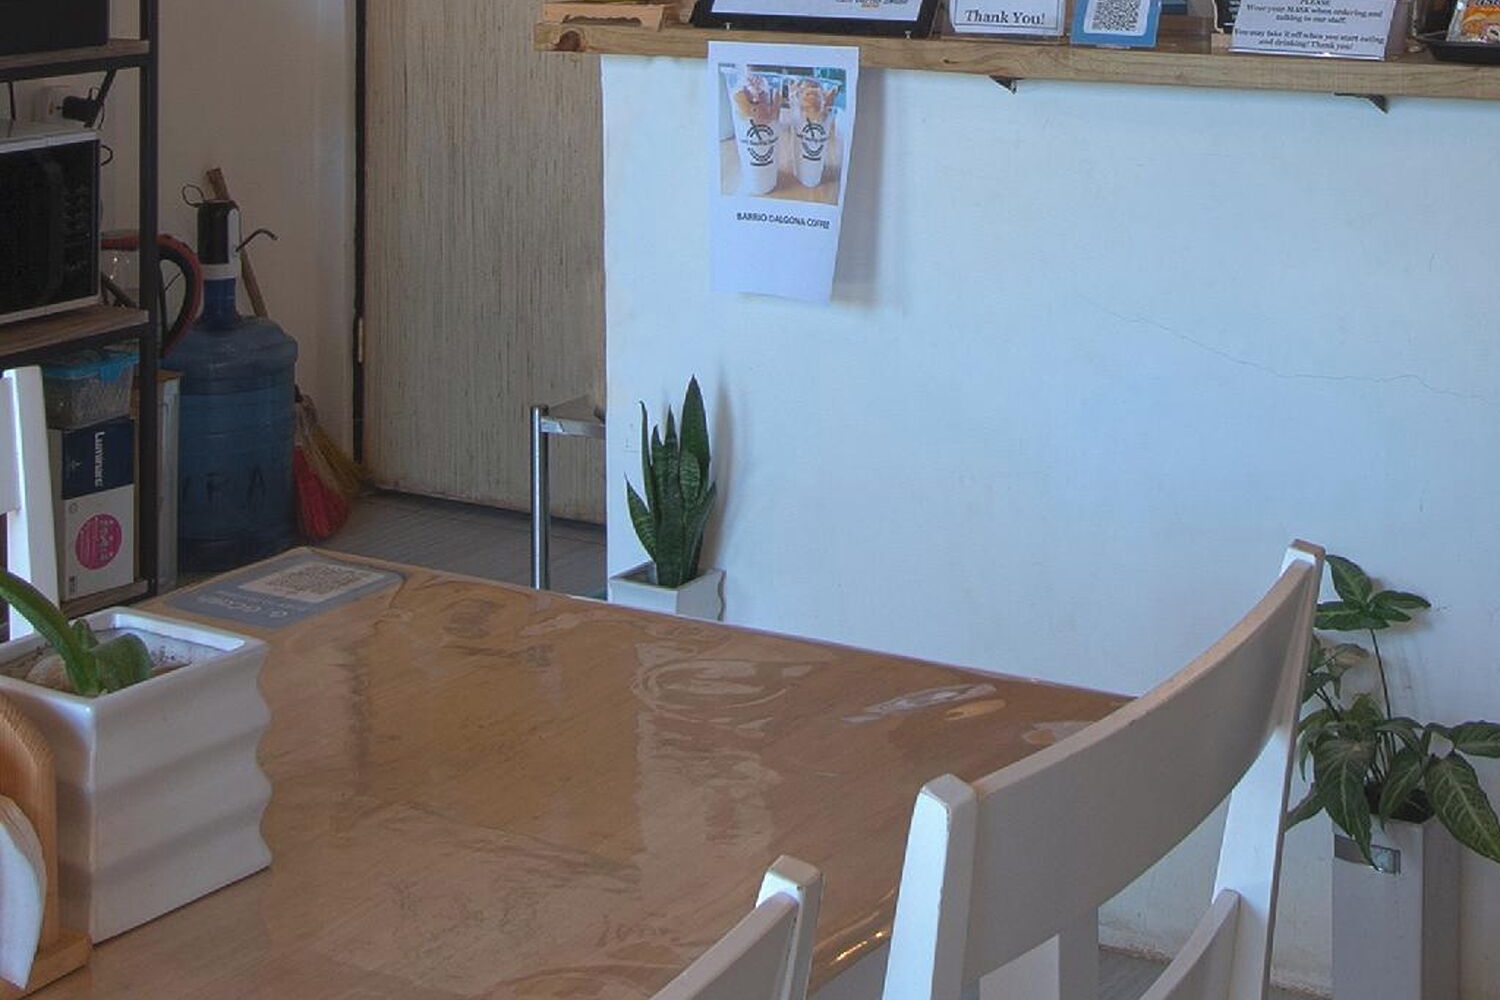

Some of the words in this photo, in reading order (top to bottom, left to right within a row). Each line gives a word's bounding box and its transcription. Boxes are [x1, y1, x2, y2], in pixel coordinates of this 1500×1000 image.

[965, 9, 1009, 25] Thank
[1013, 11, 1046, 26] You!
[1287, 6, 1310, 14] MASK
[1340, 33, 1359, 42] start
[736, 211, 768, 222] BARRIO
[769, 213, 806, 226] DALGONA
[806, 217, 830, 229] COFFEE
[94, 431, 105, 488] Luminarc
